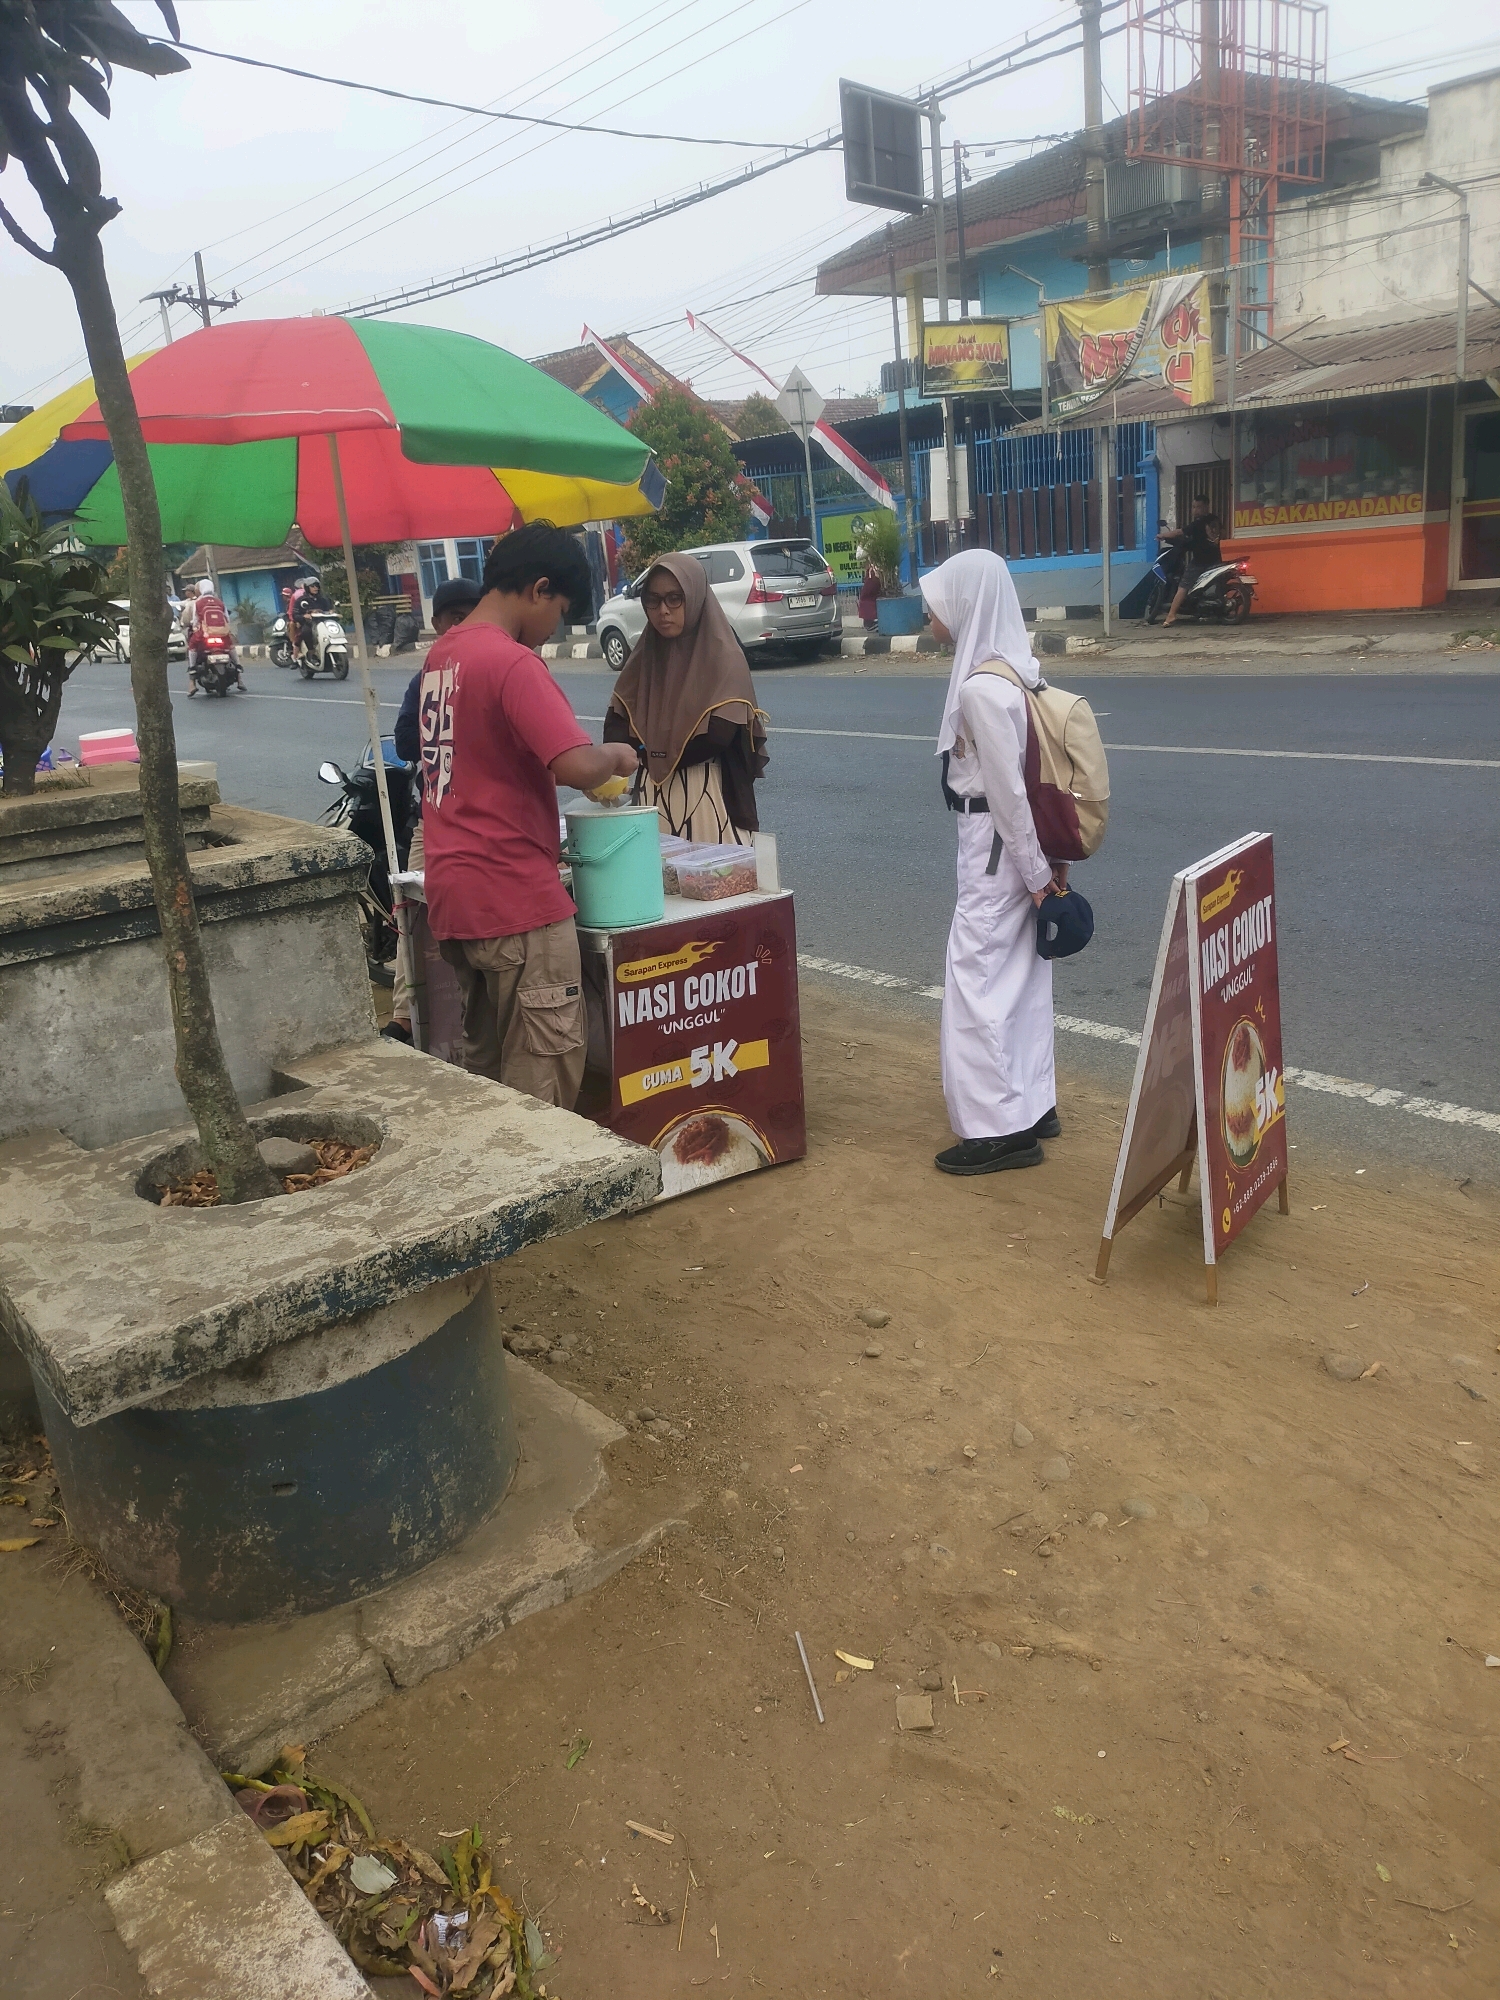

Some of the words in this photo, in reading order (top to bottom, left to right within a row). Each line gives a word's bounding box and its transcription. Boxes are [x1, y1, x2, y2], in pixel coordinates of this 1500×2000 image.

[927, 343, 975, 370] MINANG
[975, 342, 1005, 365] JAYA
[1202, 896, 1217, 916] Sarapan
[1216, 890, 1230, 907] Express
[624, 963, 656, 977] Sarapan
[658, 956, 688, 971] Express
[1202, 922, 1230, 995] NASI
[1232, 894, 1273, 967] COKOT
[618, 981, 675, 1027] NASI
[684, 962, 758, 1010] COKOT
[644, 1067, 682, 1091] CUMA
[690, 1039, 738, 1088] 5K
[1255, 1066, 1279, 1131] 5K
